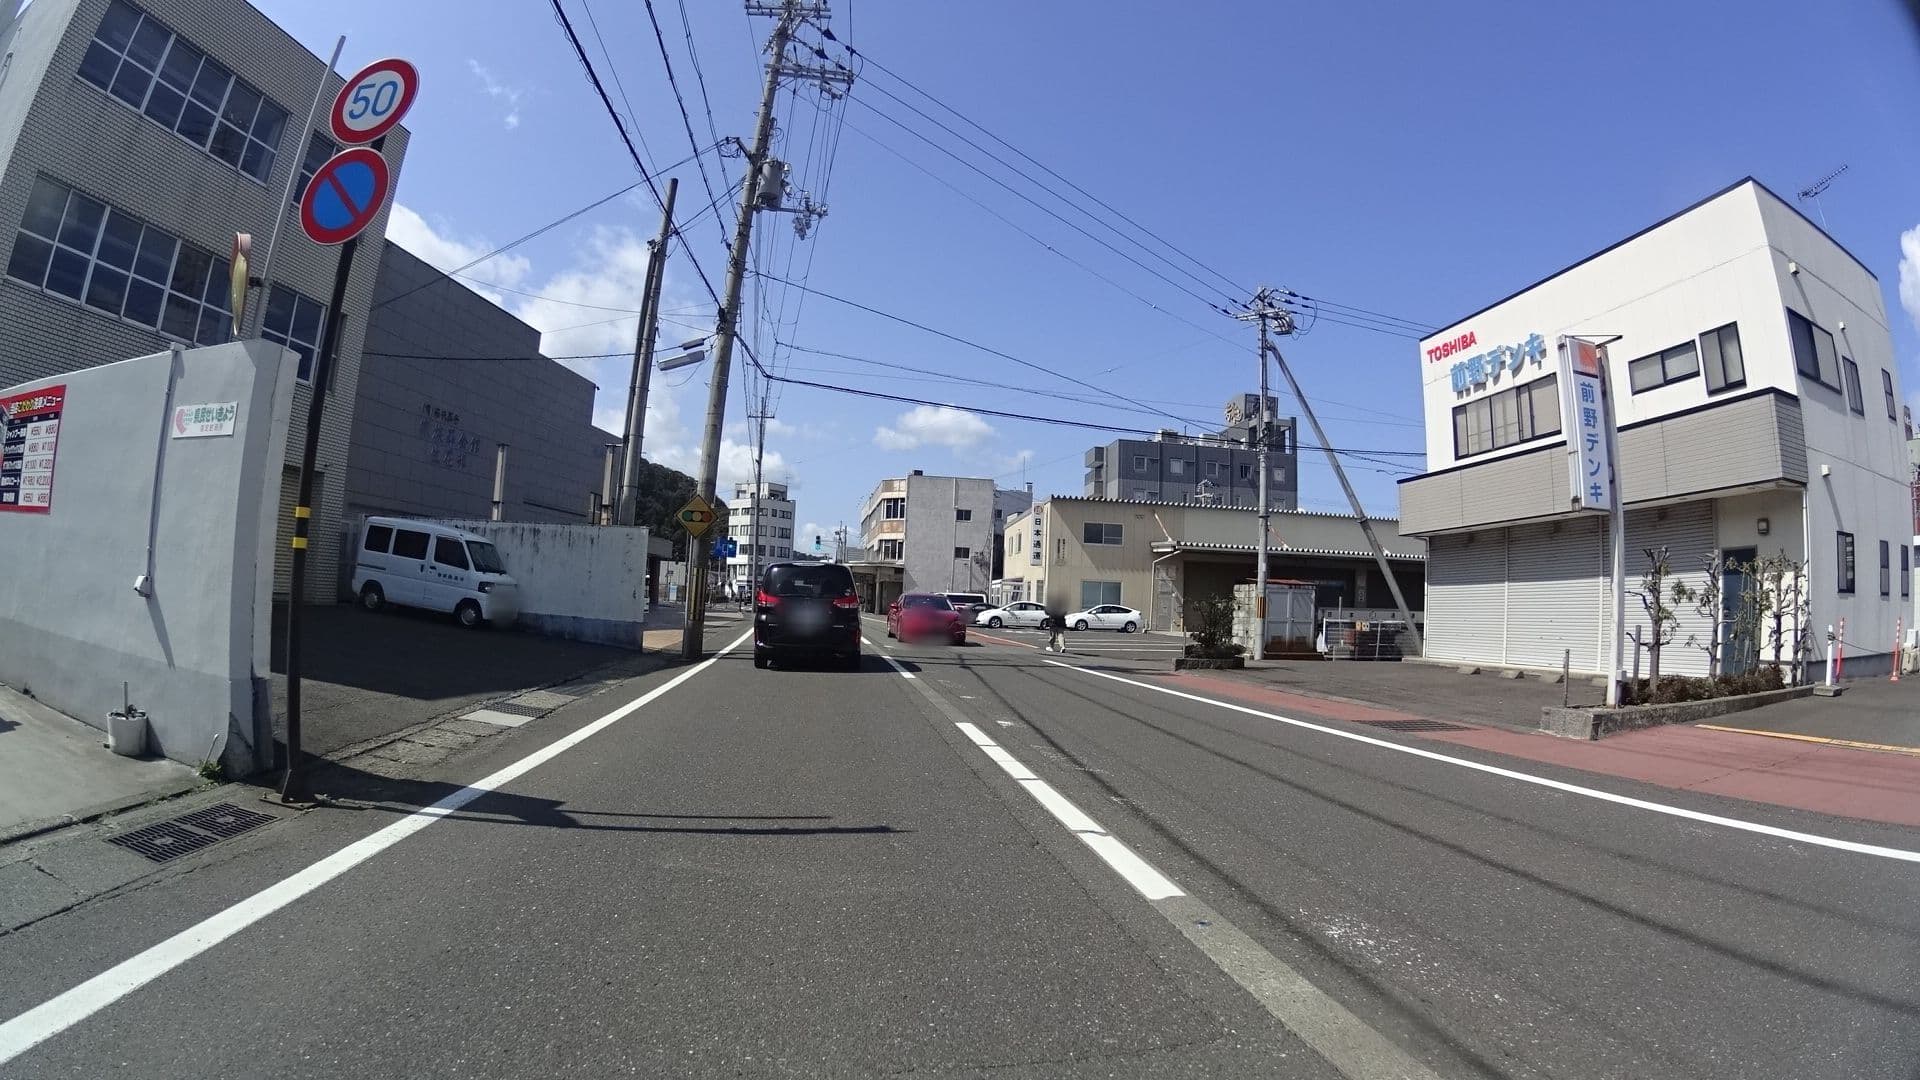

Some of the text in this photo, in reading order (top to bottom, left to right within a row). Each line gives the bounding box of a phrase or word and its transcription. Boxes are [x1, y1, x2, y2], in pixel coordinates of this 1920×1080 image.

[348, 80, 398, 119] 50
[1427, 331, 1477, 363] TOSHIBA
[1450, 333, 1547, 398] 前野デンキ
[1580, 381, 1603, 503] 前野デンキ
[1033, 518, 1042, 560] 日本通運
